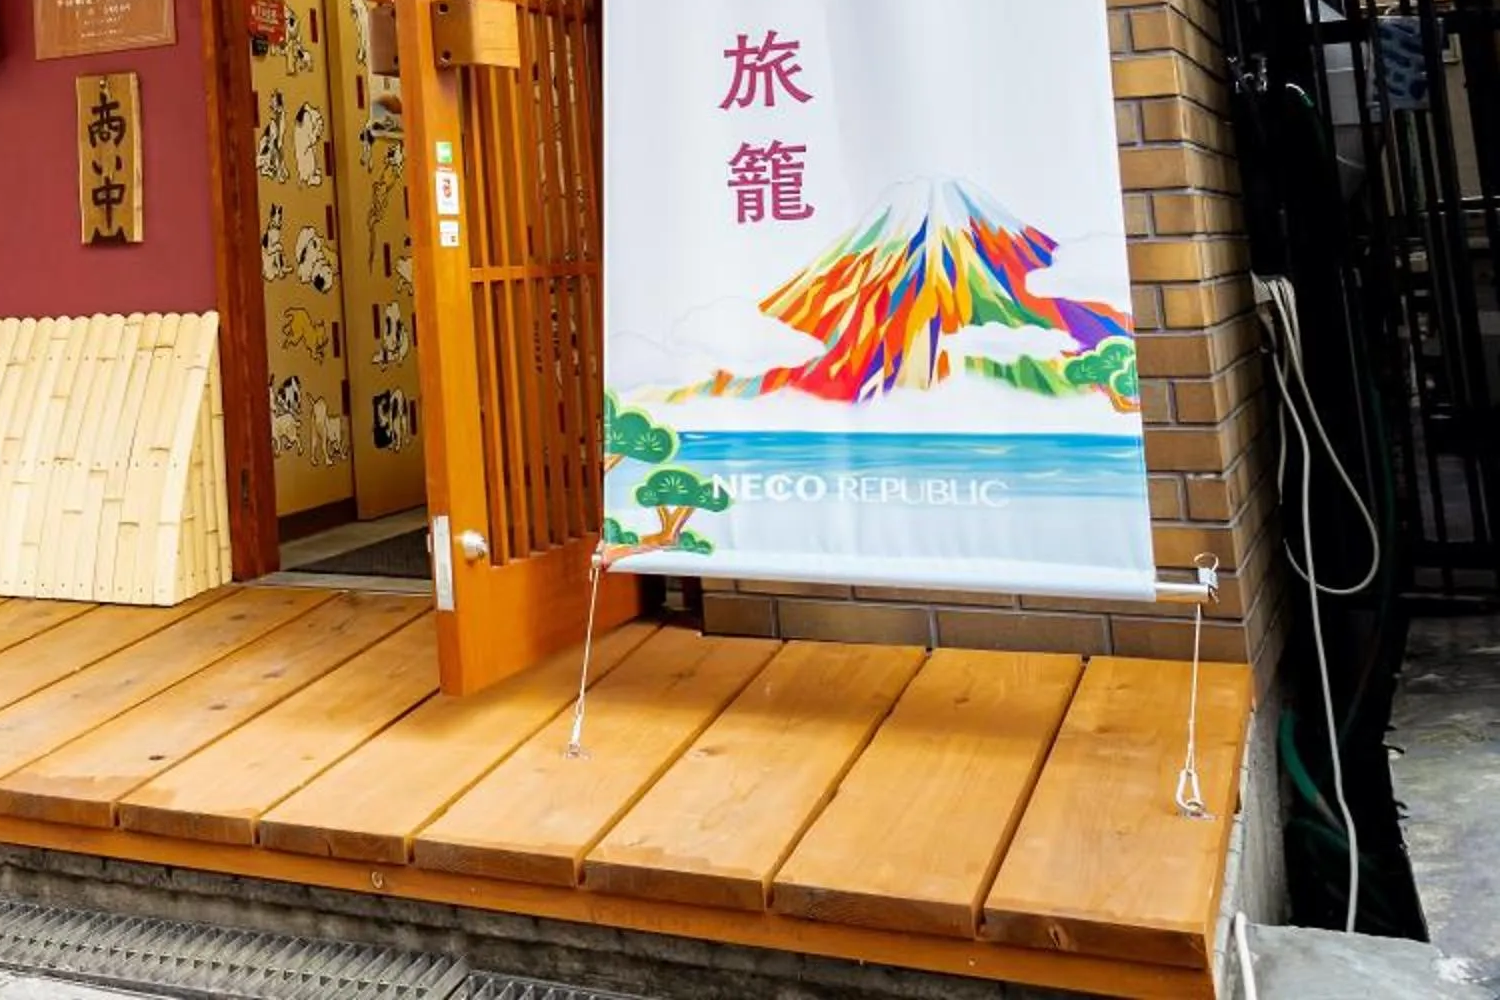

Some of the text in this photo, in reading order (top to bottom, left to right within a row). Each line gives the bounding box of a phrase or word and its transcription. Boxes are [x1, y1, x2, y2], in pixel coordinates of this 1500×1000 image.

[88, 92, 126, 230] 商い中
[711, 472, 1011, 508] NECO REPUBLIC
